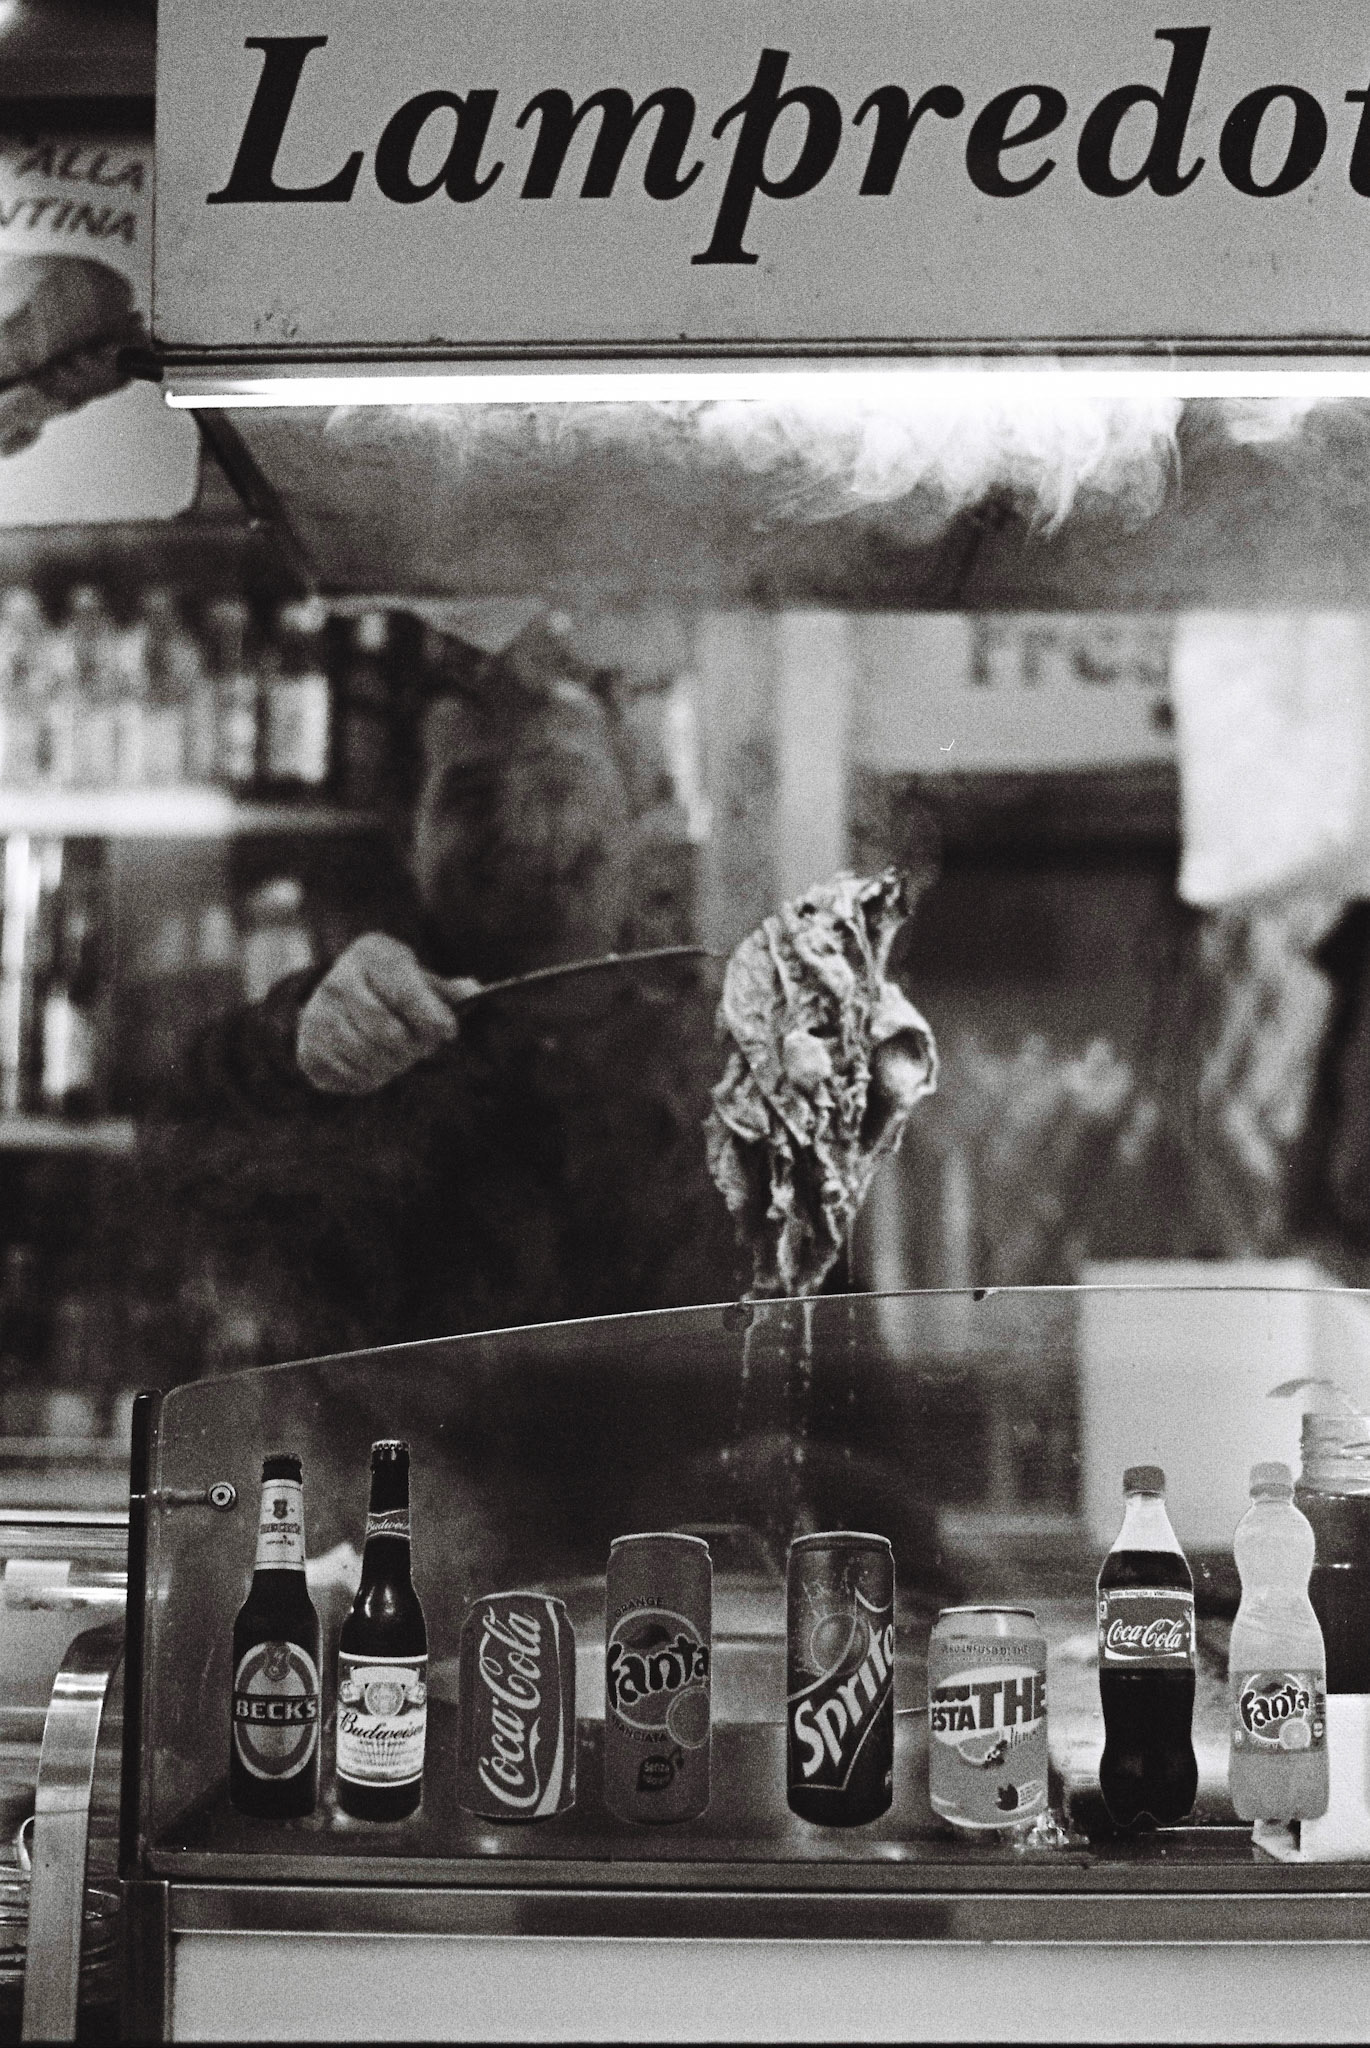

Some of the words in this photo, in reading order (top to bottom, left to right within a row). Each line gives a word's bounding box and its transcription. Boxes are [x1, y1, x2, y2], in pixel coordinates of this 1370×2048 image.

[1107, 1618, 1185, 1648] Coca-Cola
[478, 1605, 542, 1808] Coca-Cola
[606, 1640, 709, 1711] Fanta
[794, 1620, 893, 1778] Sprite
[1240, 1683, 1311, 1733] Fanta
